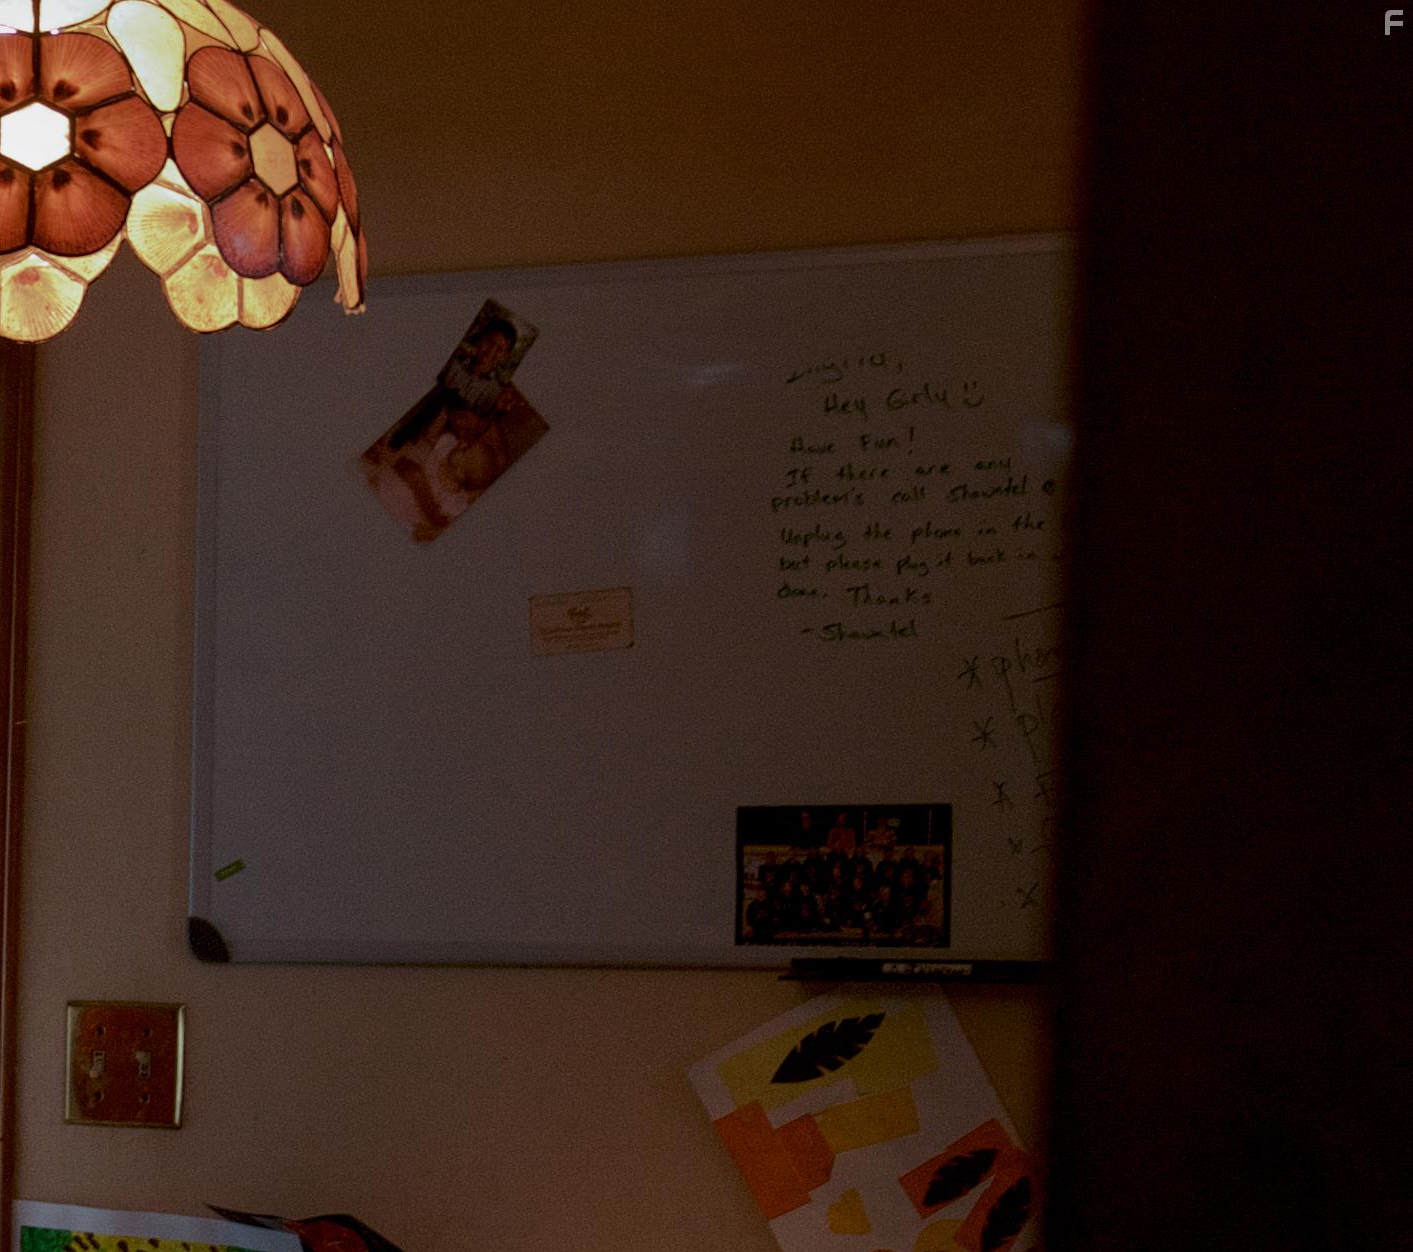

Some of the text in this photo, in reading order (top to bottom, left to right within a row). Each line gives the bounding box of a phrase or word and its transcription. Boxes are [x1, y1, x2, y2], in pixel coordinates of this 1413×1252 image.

[824, 392, 868, 422] Hey
[859, 426, 916, 456] Fun!
[785, 457, 1012, 489] If there are any
[889, 486, 926, 505] call
[779, 523, 849, 550] Unplug
[863, 521, 892, 541] the
[910, 520, 962, 544] phone
[1011, 512, 1046, 532] the
[825, 552, 884, 574] please
[896, 553, 930, 577] plug
[845, 582, 933, 607] Thanks
